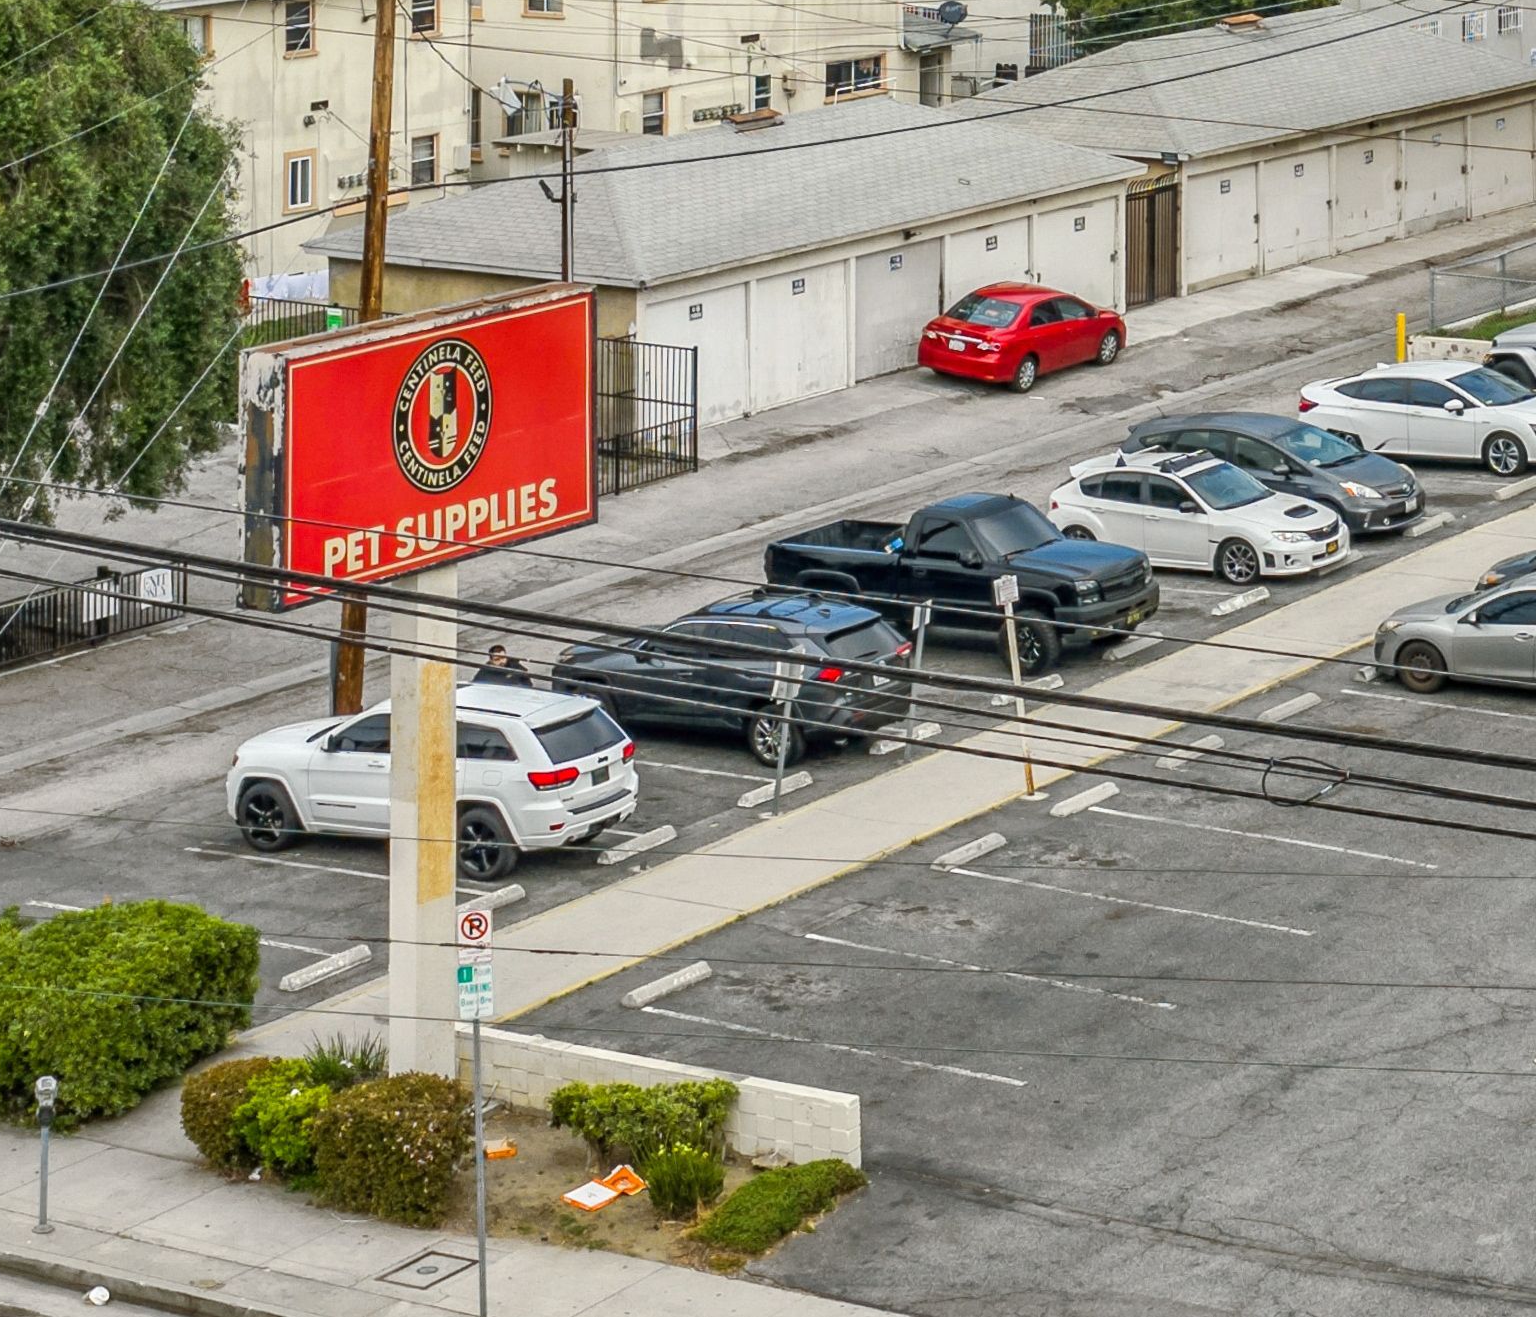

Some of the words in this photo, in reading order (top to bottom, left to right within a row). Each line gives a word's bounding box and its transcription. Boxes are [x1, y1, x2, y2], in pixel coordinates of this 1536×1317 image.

[398, 346, 463, 412] CENTINELA
[463, 354, 488, 394] FEED
[397, 439, 463, 486] CENTINELA
[464, 418, 486, 475] FEED
[323, 524, 387, 578] PET
[395, 478, 559, 560] SUPPLIES
